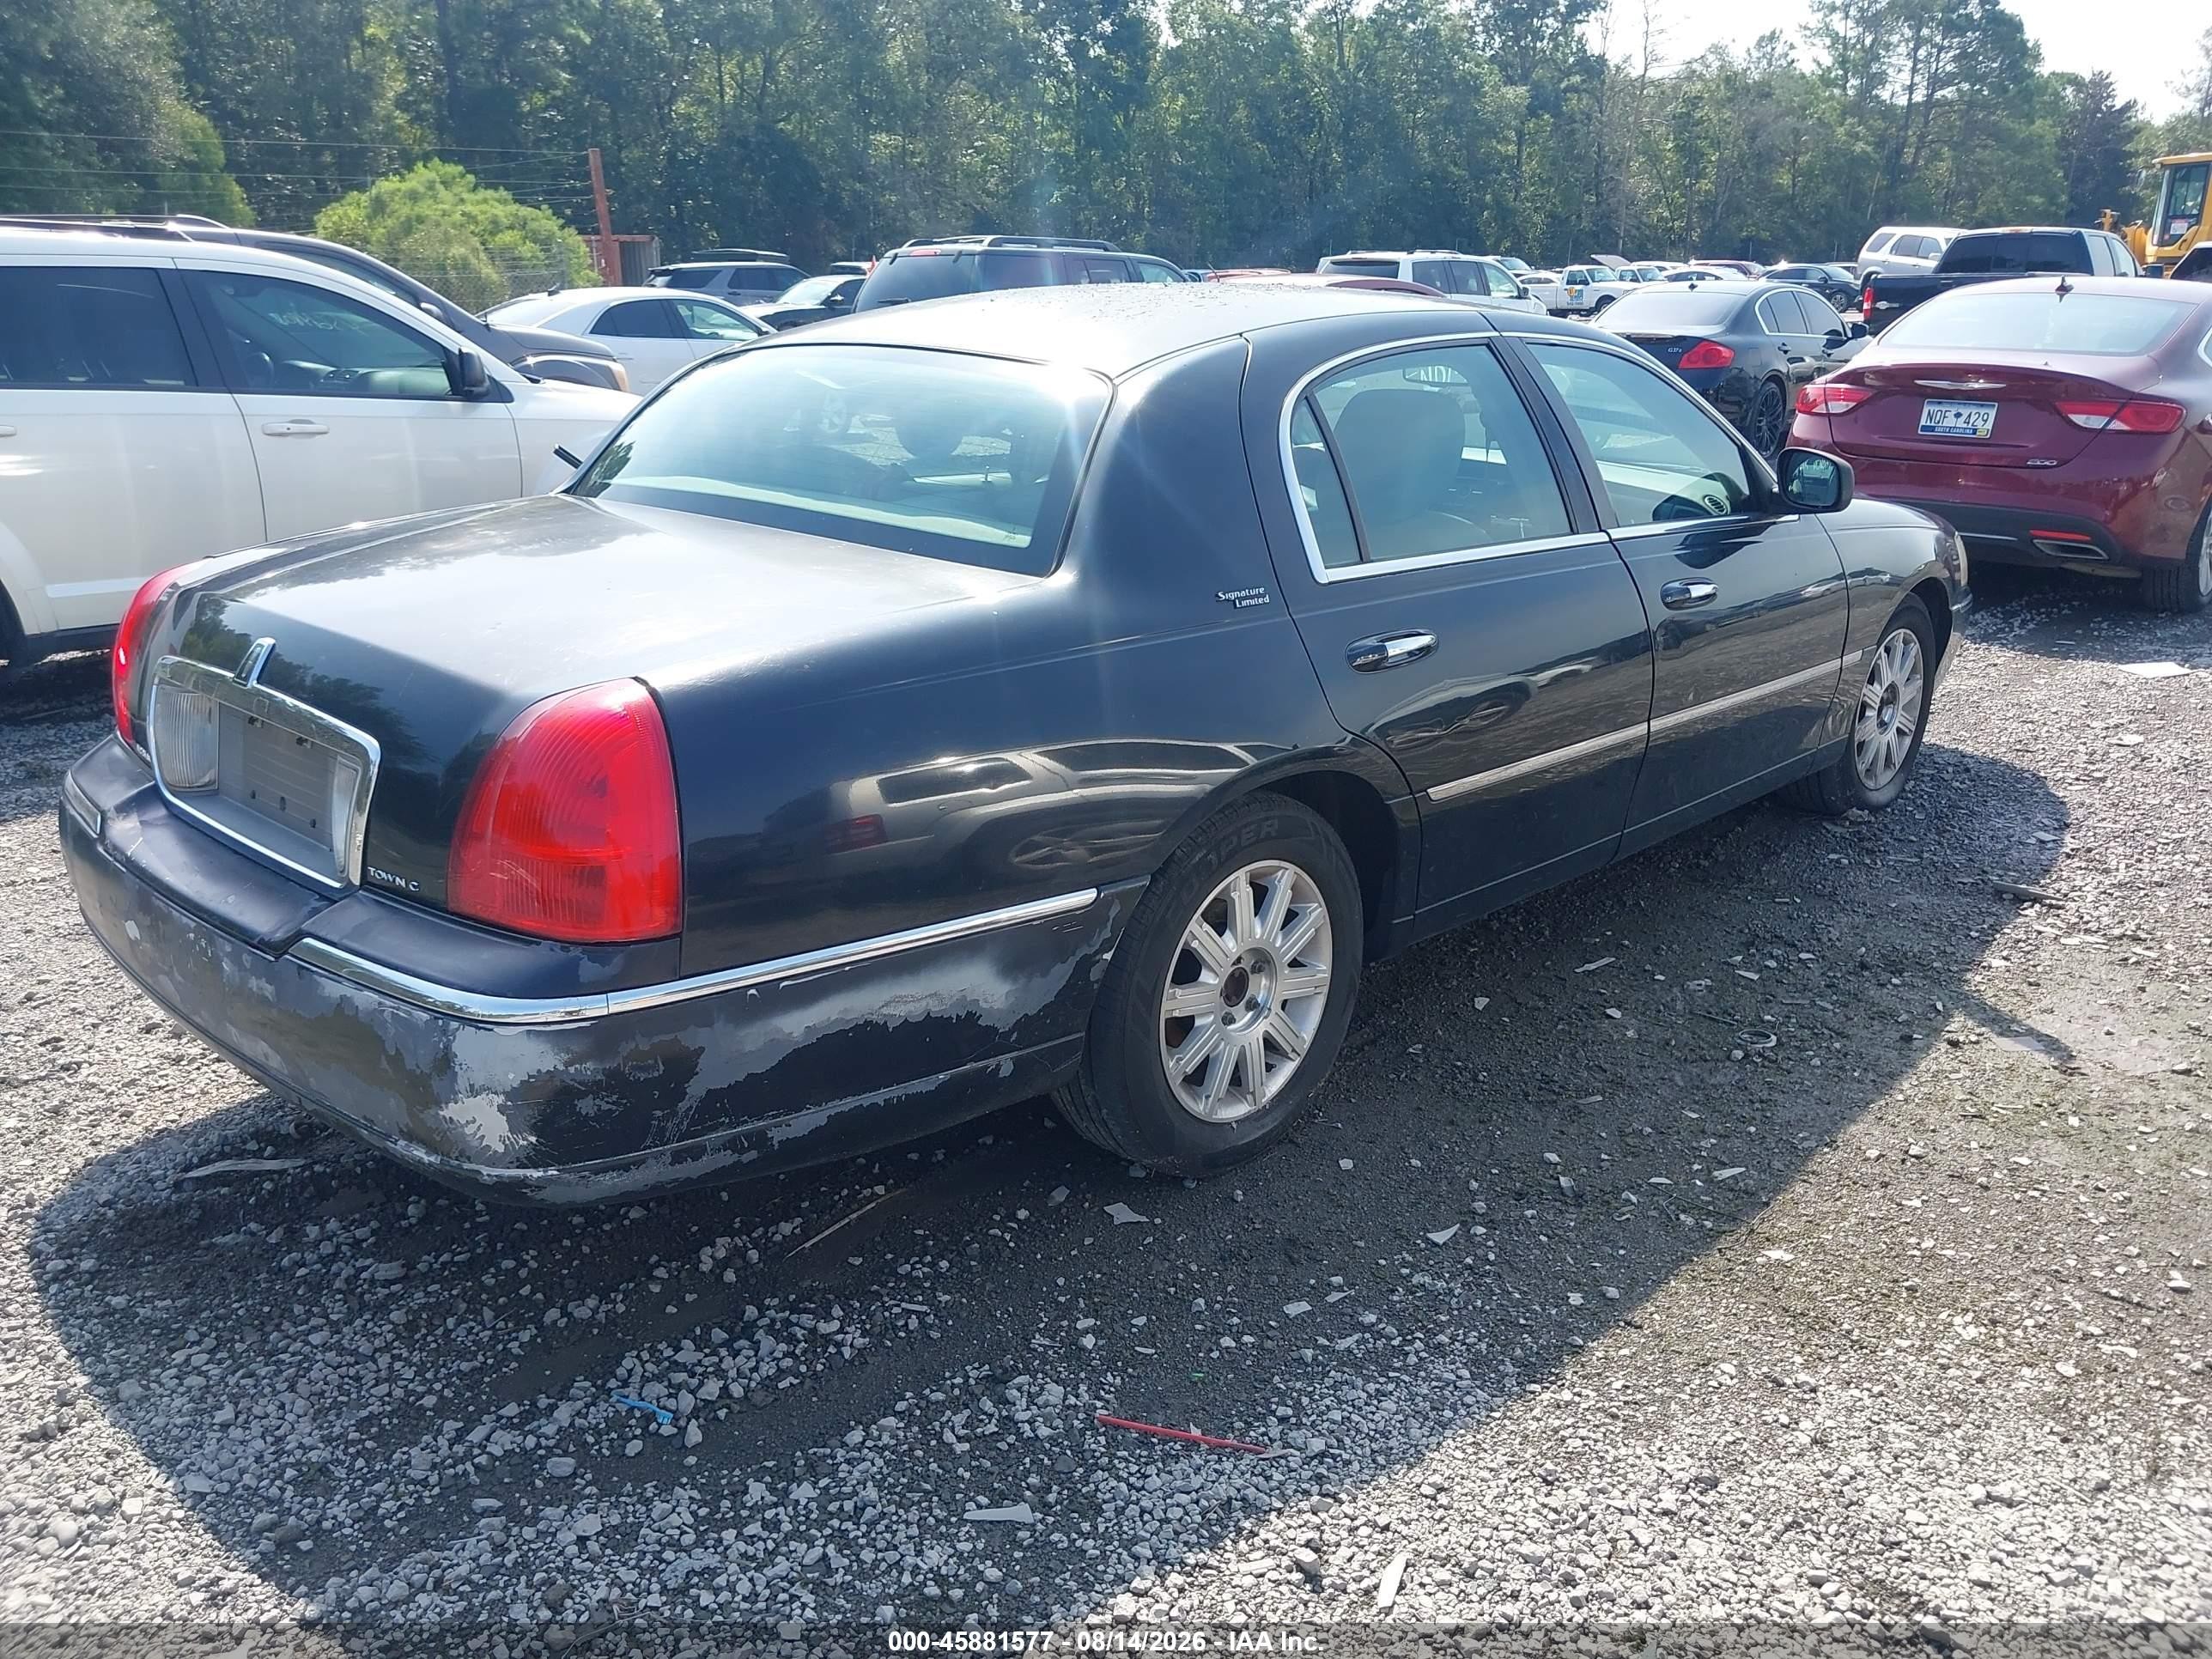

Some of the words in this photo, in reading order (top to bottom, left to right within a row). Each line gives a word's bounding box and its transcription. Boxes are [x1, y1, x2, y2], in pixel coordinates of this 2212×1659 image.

[1963, 411, 1990, 428] 429
[1218, 587, 1265, 600] Signature
[1235, 594, 1270, 608] Limited
[368, 866, 406, 888] TOWN
[409, 881, 420, 891] C
